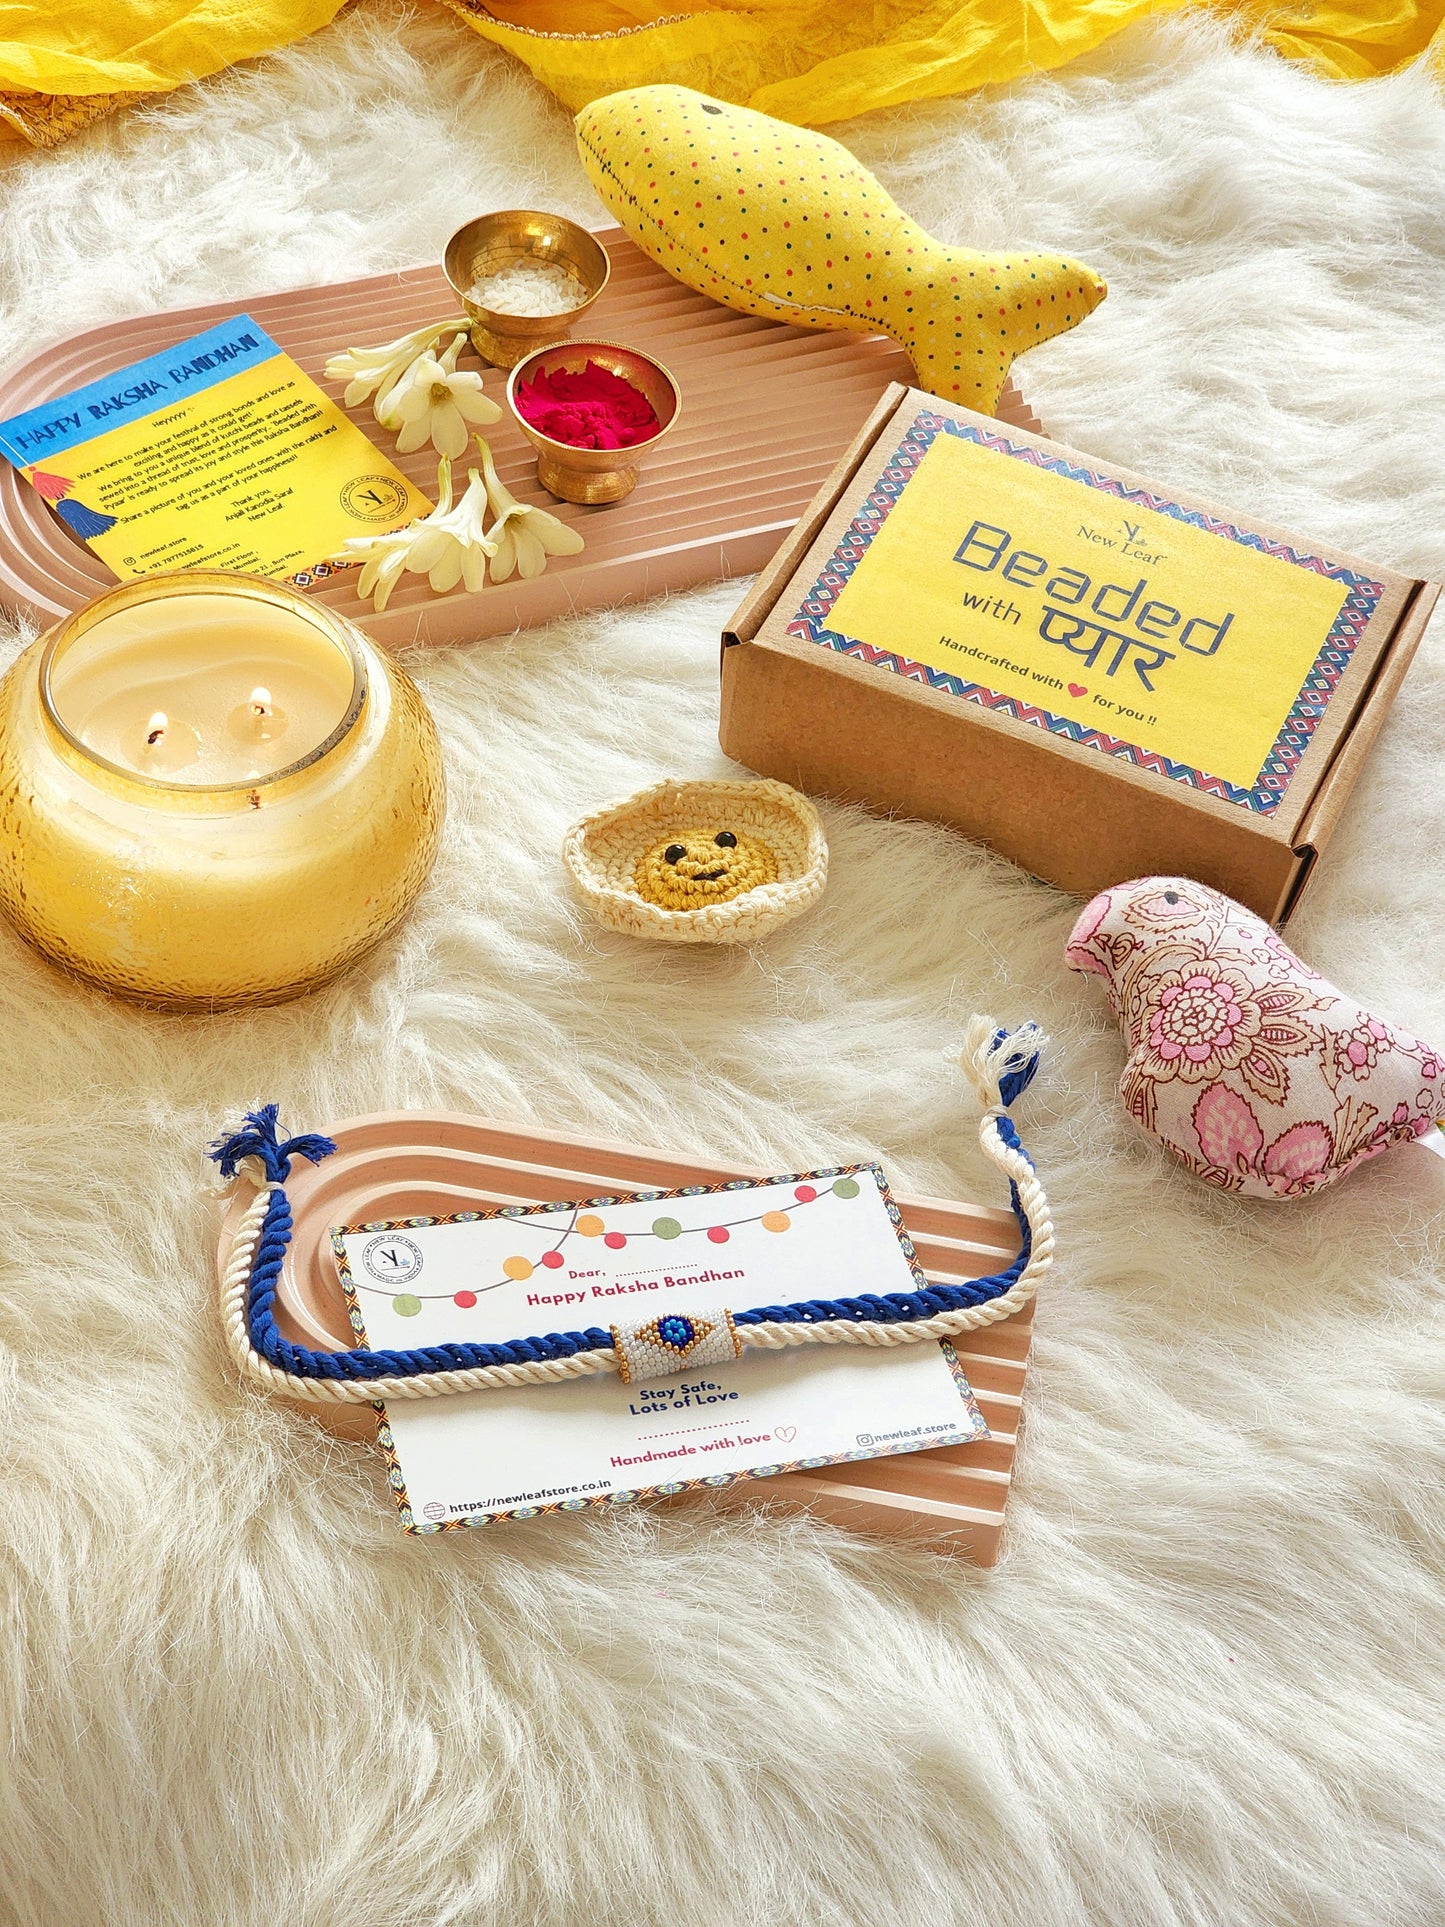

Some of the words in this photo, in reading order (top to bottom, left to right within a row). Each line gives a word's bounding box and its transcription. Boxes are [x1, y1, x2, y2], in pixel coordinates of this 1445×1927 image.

[16, 412, 81, 449] HAPPY
[87, 379, 168, 420] RAKSHA
[168, 333, 259, 384] BANDHAN
[77, 472, 92, 481] We
[93, 466, 105, 475] are
[105, 459, 123, 469] here
[134, 445, 154, 458] make
[154, 437, 171, 449] your
[172, 425, 200, 440] festival
[199, 420, 208, 428] of
[209, 410, 234, 424] strong
[232, 400, 255, 413] bonds
[256, 392, 270, 403] and
[268, 386, 286, 396] love
[97, 484, 113, 493] We
[112, 474, 135, 487] bring
[143, 463, 159, 475] you
[166, 450, 191, 464] unique
[189, 440, 212, 453] blend
[211, 436, 220, 444] of
[219, 426, 243, 440] kutchi
[242, 417, 265, 430] beads
[265, 409, 279, 420] and
[278, 398, 304, 413] tassels
[98, 488, 125, 503] sewed
[123, 482, 141, 492] into
[146, 468, 172, 482] thread
[171, 464, 180, 472] of
[199, 449, 217, 460] love
[216, 442, 232, 452] and
[299, 402, 318, 414] with
[133, 452, 164, 467] exciting
[163, 445, 178, 455] and
[176, 436, 200, 449] happy
[217, 418, 237, 431] could
[120, 512, 143, 525] Share
[149, 498, 177, 514] picture
[176, 492, 186, 501] of
[186, 487, 202, 498] you
[202, 480, 217, 490] and
[216, 472, 234, 485] your
[234, 462, 257, 476] loved
[256, 455, 275, 466] ones
[274, 446, 293, 457] with
[291, 441, 305, 450] the
[323, 424, 338, 435] and
[127, 494, 136, 502] is
[136, 485, 158, 498] ready
[158, 480, 168, 488] to
[169, 469, 194, 483] spread
[193, 465, 204, 473] its
[204, 459, 217, 470] joy
[217, 452, 232, 462] and
[232, 445, 251, 455] style
[250, 438, 265, 448] this
[264, 426, 290, 441] Raksha
[175, 503, 191, 512] tag
[199, 494, 210, 502] as
[216, 484, 231, 496] part
[231, 479, 241, 488] of
[241, 472, 259, 485] your
[225, 509, 246, 522] Anjali
[244, 496, 275, 513] Kanodia
[230, 495, 254, 508] Thank
[247, 511, 267, 522] New
[220, 558, 237, 568] First
[236, 550, 255, 561] Floor
[1076, 524, 1118, 549] New
[1120, 542, 1163, 567] Leaf
[952, 520, 1235, 657] Beaded
[962, 590, 1022, 627] with
[1038, 604, 1177, 692] प्यार
[939, 635, 1030, 677] Handcrafted
[1031, 671, 1065, 691] with
[1092, 694, 1113, 710] for
[1115, 705, 1146, 722] you
[526, 1289, 588, 1307] Happy
[591, 1279, 660, 1298] Raksha
[663, 1268, 746, 1288] Bandhan
[568, 1269, 607, 1280] Dear,
[629, 1402, 669, 1416] Lots
[673, 1397, 692, 1409] of
[695, 1390, 740, 1406] Love
[639, 1387, 677, 1401] Stay
[680, 1380, 723, 1395] Safe,
[610, 1445, 698, 1468] Handmade
[699, 1437, 736, 1453] with
[738, 1433, 772, 1447] love
[874, 1423, 958, 1443] newleaf.store
[449, 1479, 612, 1514] https://newleafstore.co.in
